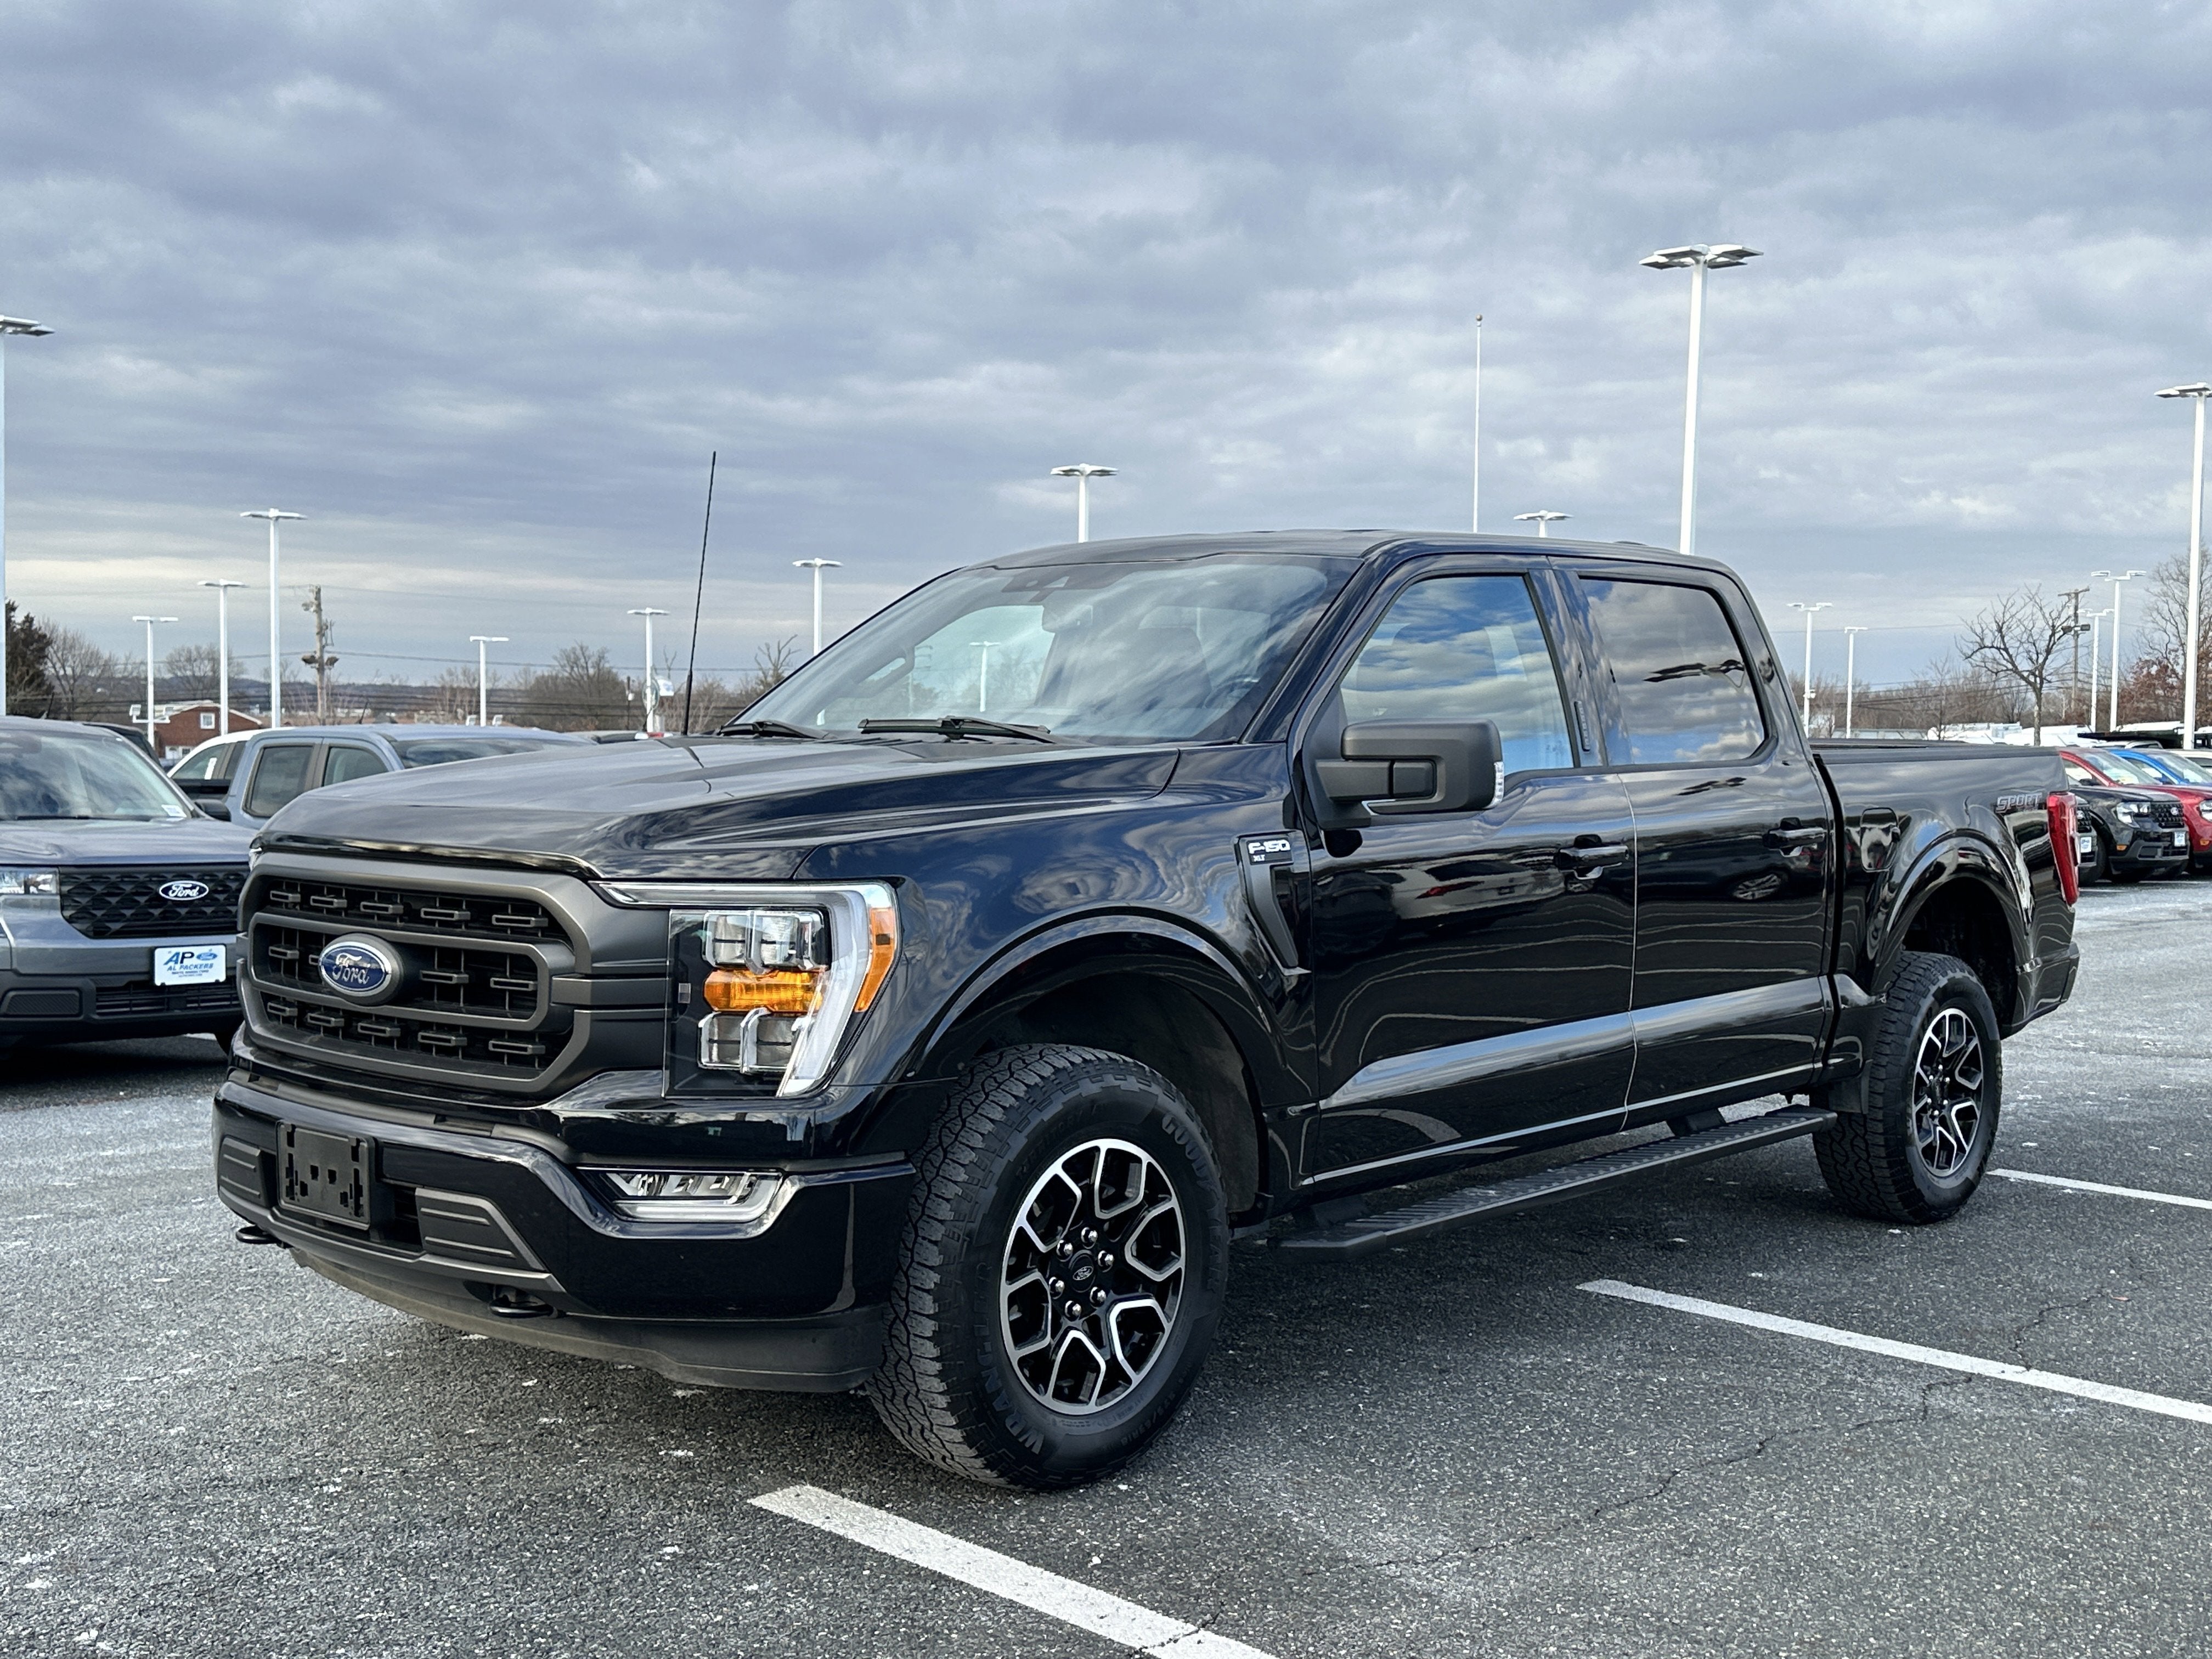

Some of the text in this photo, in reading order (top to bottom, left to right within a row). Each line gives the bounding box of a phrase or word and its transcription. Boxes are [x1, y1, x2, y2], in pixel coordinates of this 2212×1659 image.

[1995, 793, 2042, 812] SPORT
[1248, 840, 1290, 854] F-150
[168, 883, 199, 897] Ford
[163, 952, 194, 965] AP
[332, 953, 370, 984] Ford
